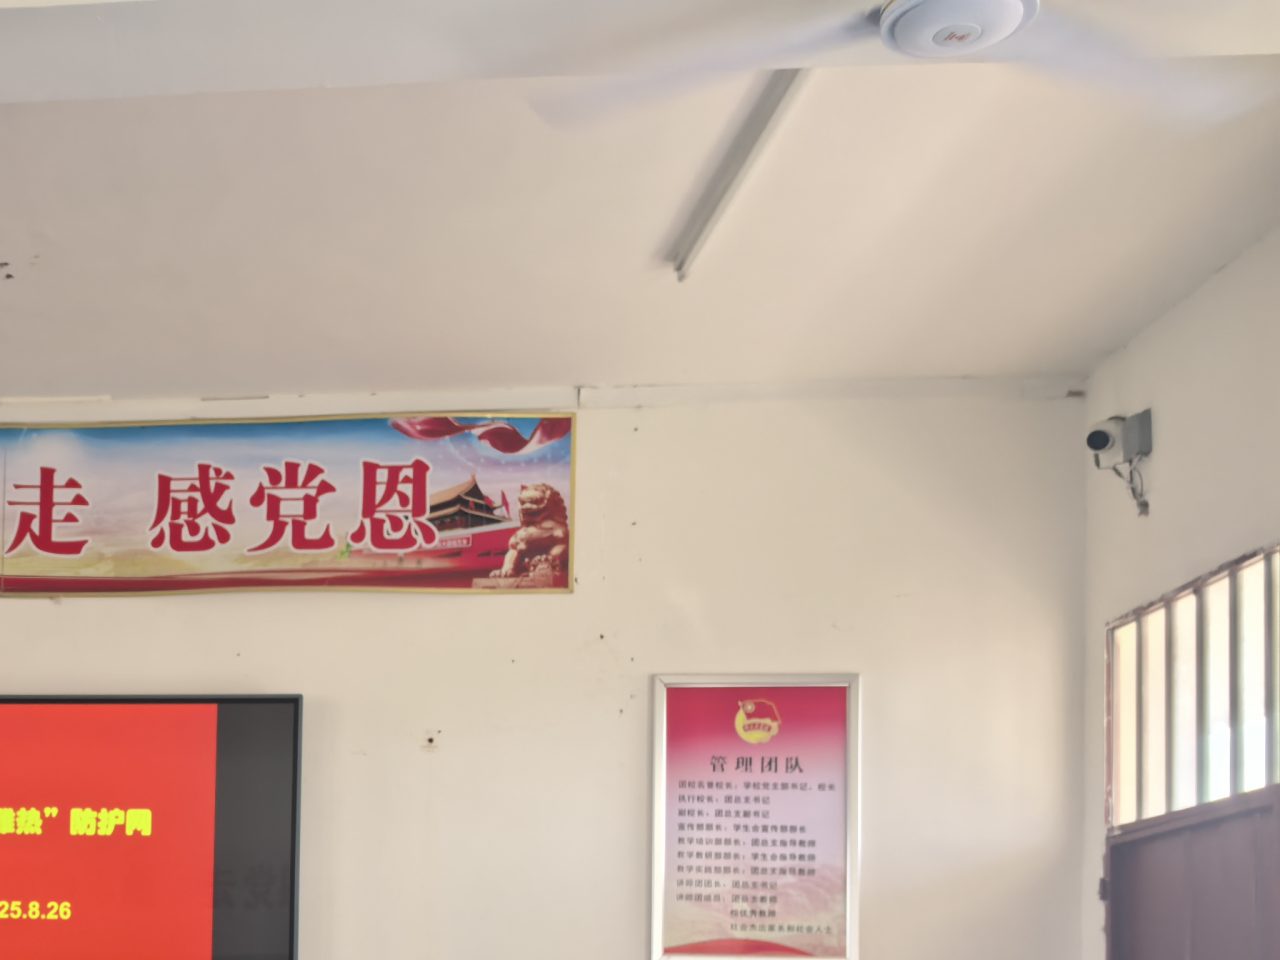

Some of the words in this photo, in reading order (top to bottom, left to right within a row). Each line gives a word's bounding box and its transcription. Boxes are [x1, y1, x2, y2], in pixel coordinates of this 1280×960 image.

[148, 458, 440, 556] 感党恩
[710, 755, 804, 773] 管理团队
